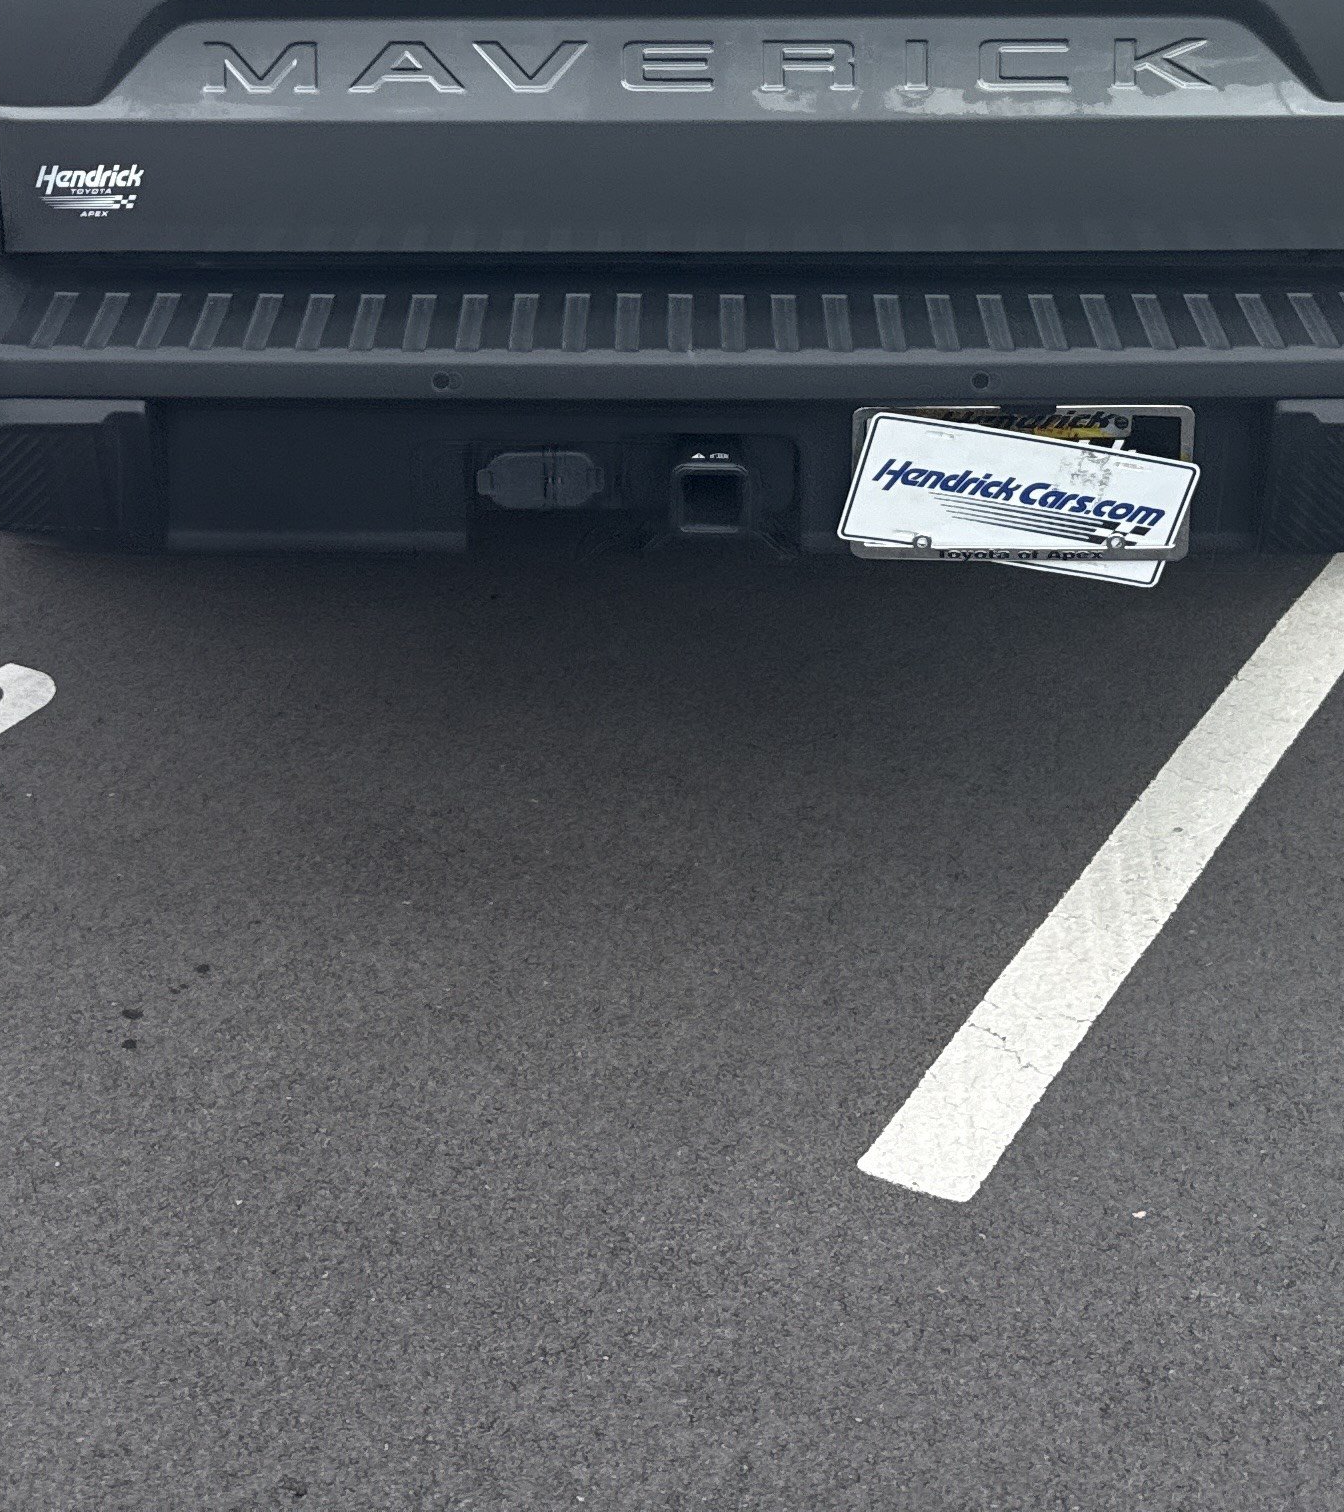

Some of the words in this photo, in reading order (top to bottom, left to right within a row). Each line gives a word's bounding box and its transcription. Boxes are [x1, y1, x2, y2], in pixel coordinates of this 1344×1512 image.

[201, 39, 1215, 94] MAVERICK
[35, 164, 145, 195] Hendrick
[79, 210, 109, 218] APEX
[939, 548, 1010, 561] Toyota
[1017, 550, 1039, 560] of
[1047, 550, 1104, 561] Apex
